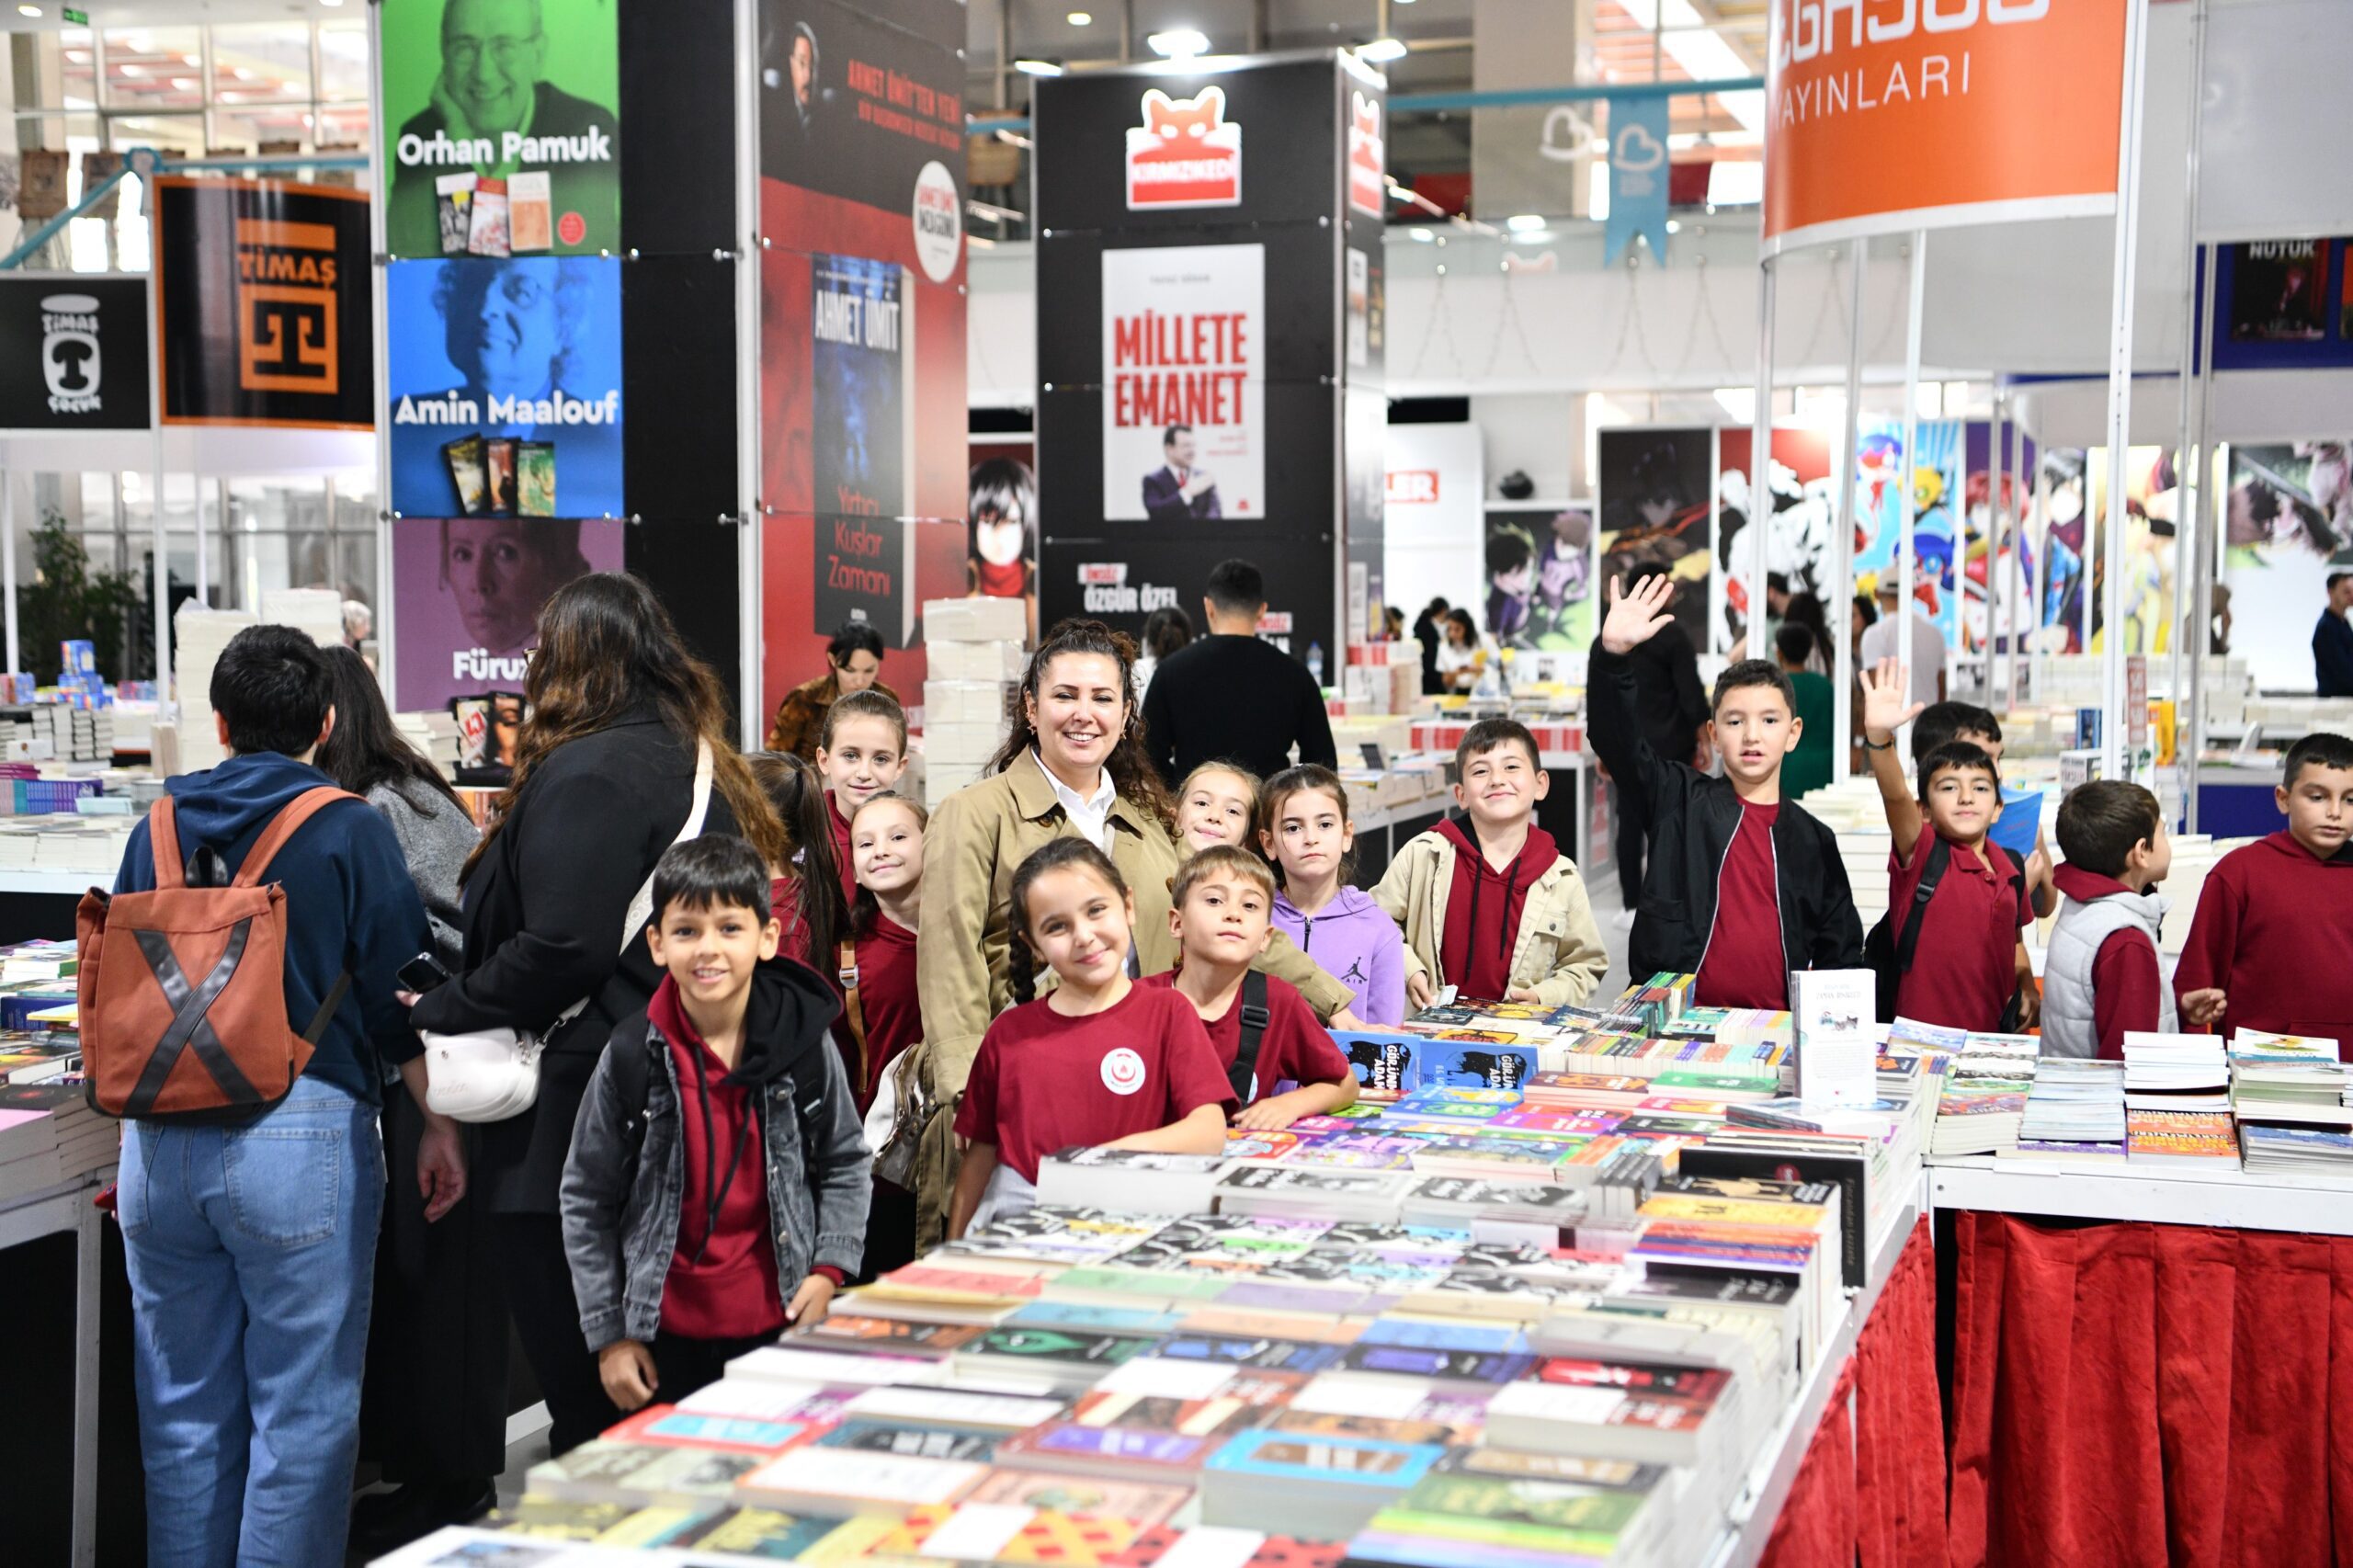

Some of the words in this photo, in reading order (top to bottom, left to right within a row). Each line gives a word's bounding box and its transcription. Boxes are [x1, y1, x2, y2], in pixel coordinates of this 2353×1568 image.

[396, 132, 493, 165] Orhan
[503, 126, 611, 164] Pamuk
[238, 244, 337, 290] TİMAŞ
[814, 289, 862, 346] AHMET
[865, 287, 900, 352] ÜMİT
[1114, 309, 1247, 368] MİLLETE
[394, 393, 478, 426] Amin
[487, 390, 619, 425] Maalouf
[1114, 371, 1247, 427] EMANET
[837, 484, 880, 517] Yırtıcı
[834, 519, 883, 561] Kuşlar
[826, 554, 892, 597] Zamanı
[1084, 584, 1139, 613] ÖZGÜR
